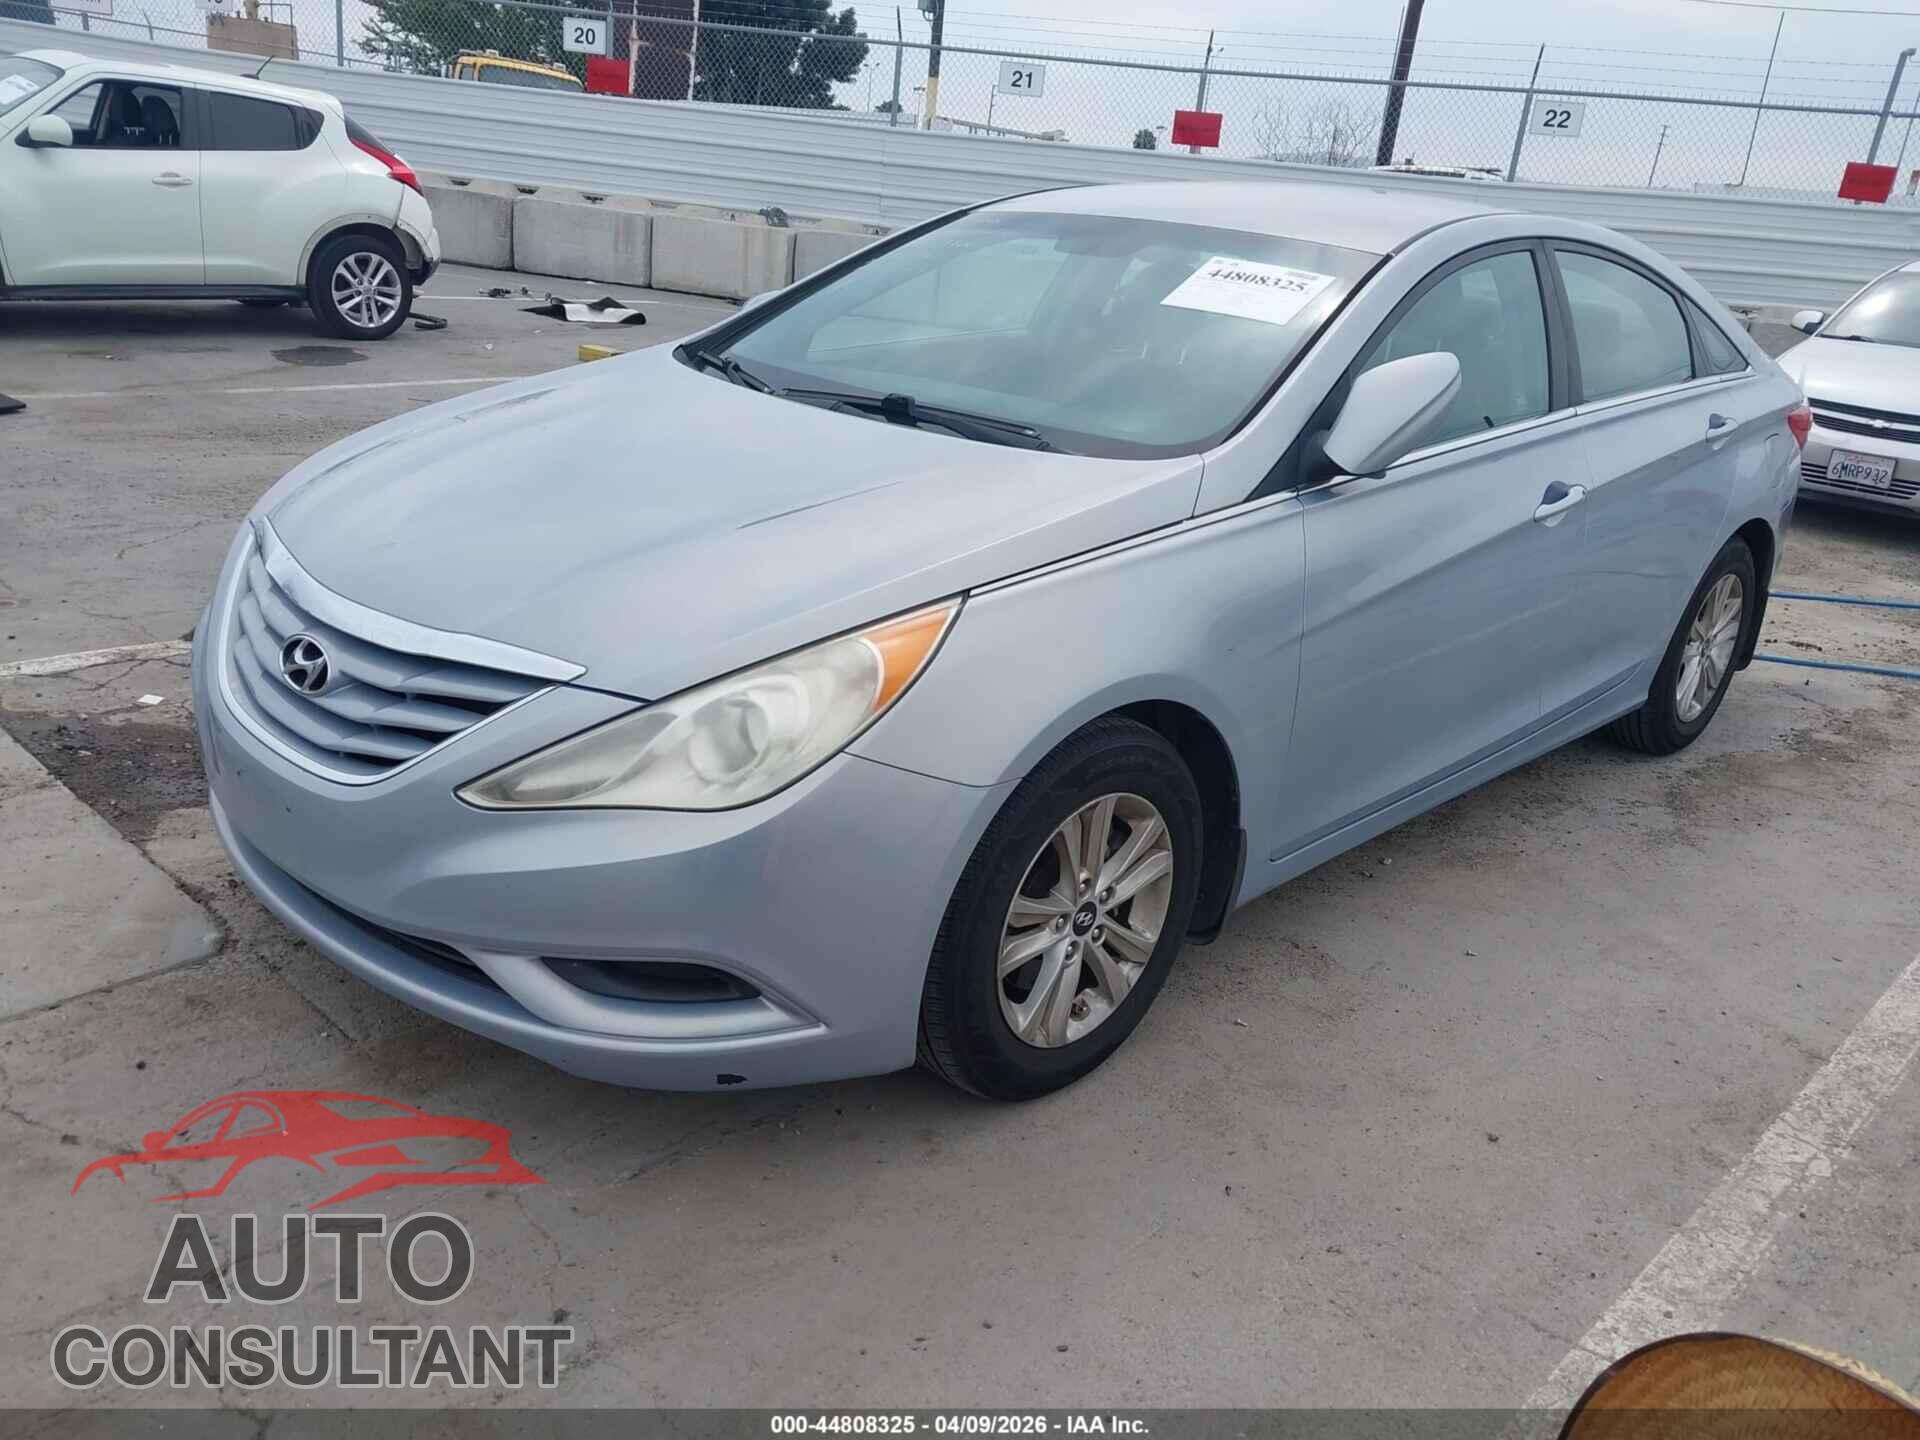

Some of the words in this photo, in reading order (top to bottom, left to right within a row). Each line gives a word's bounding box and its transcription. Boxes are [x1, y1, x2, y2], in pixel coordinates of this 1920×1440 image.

[574, 26, 596, 45] 20
[1011, 70, 1033, 89] 21
[1543, 109, 1572, 128] 22
[1208, 268, 1306, 292] 44808325
[1831, 462, 1888, 484] 6MRP932
